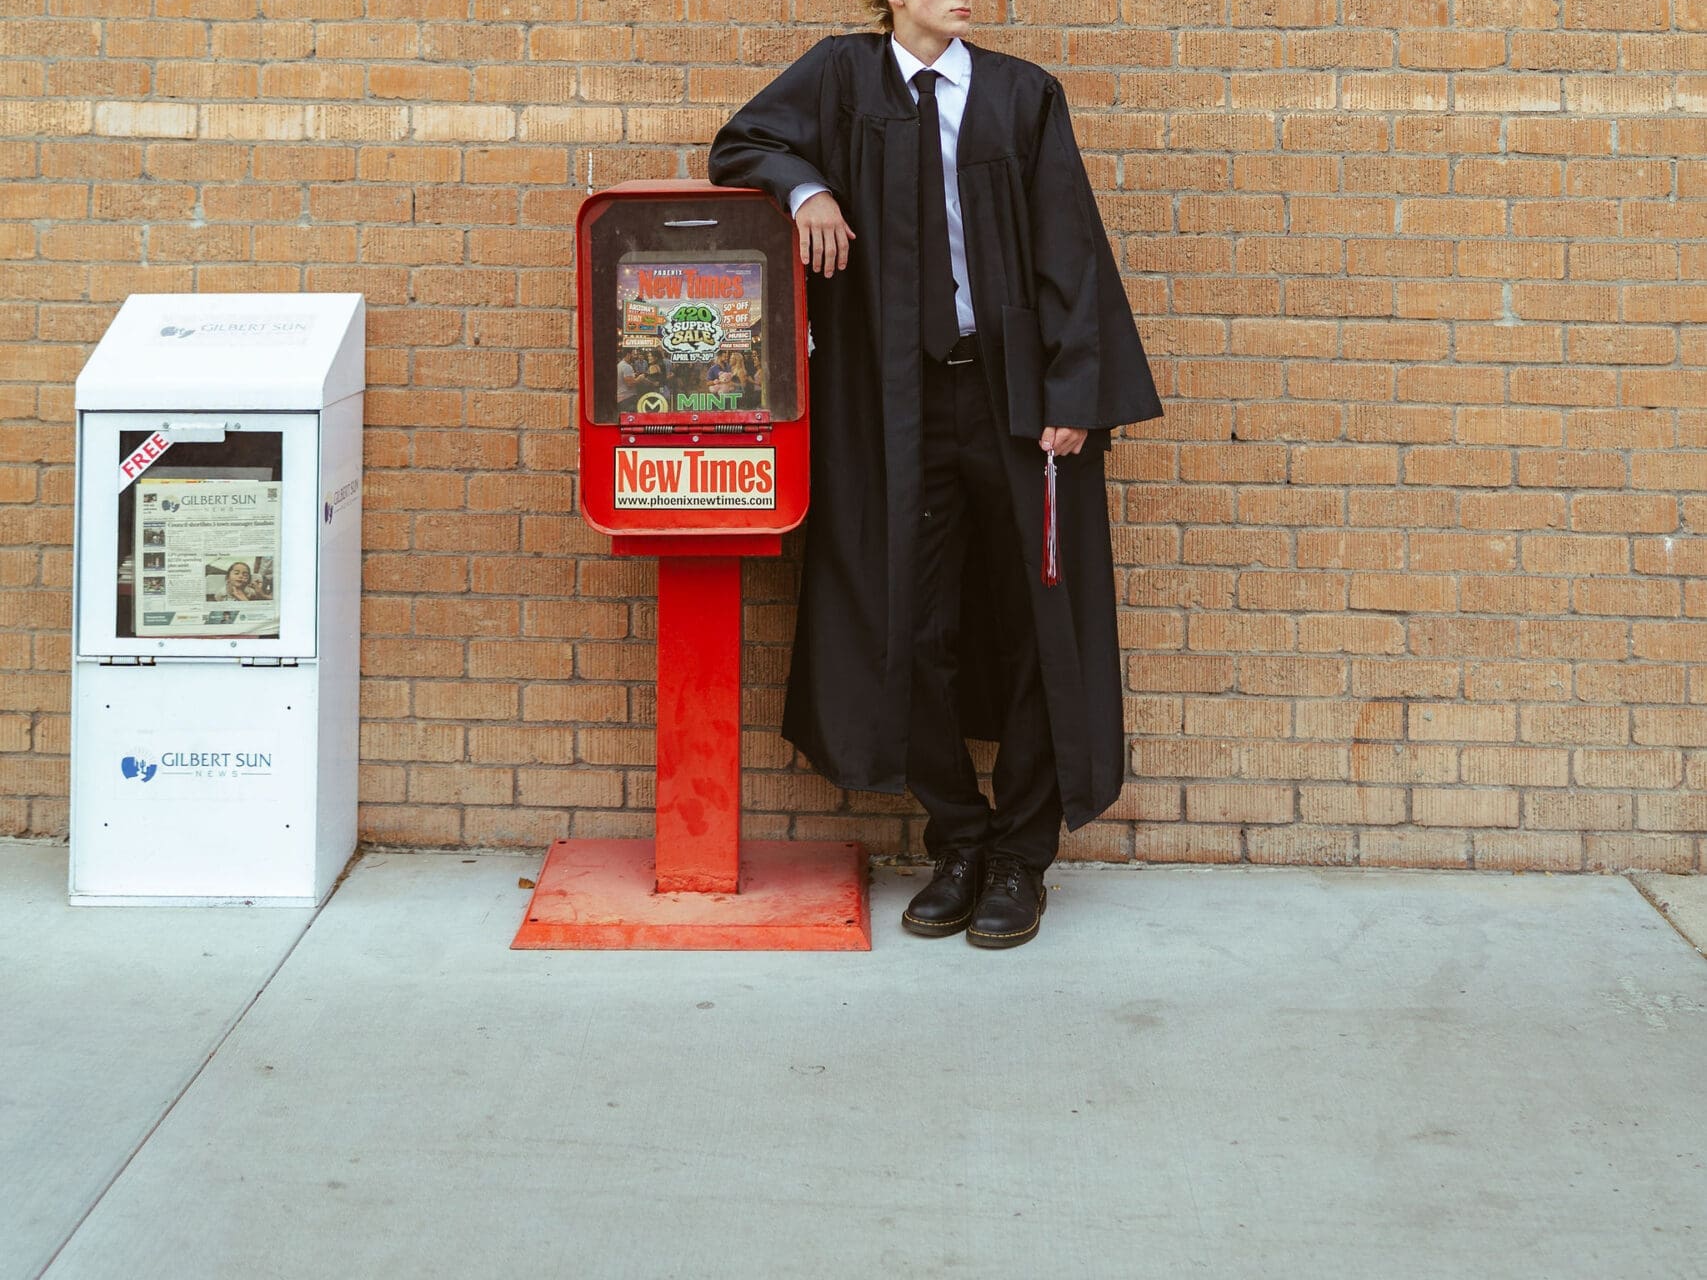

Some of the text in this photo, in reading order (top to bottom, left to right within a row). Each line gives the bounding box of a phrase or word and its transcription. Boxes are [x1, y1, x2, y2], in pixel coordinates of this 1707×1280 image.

[638, 269, 744, 299] New Times
[736, 301, 749, 310] OFF
[673, 306, 713, 322] 420
[735, 314, 749, 323] OFF
[201, 323, 306, 331] GILBERT SUN
[672, 321, 715, 332] SUPER
[671, 330, 716, 345] SALE
[673, 353, 689, 361] APRIL
[677, 392, 743, 411] MINT
[121, 433, 170, 479] FREE
[617, 450, 773, 493] New Times
[181, 494, 257, 506] GILBERT SUN
[617, 495, 773, 507] www.phoenixnewtimes.com
[161, 752, 272, 767] GILBERT SUN
